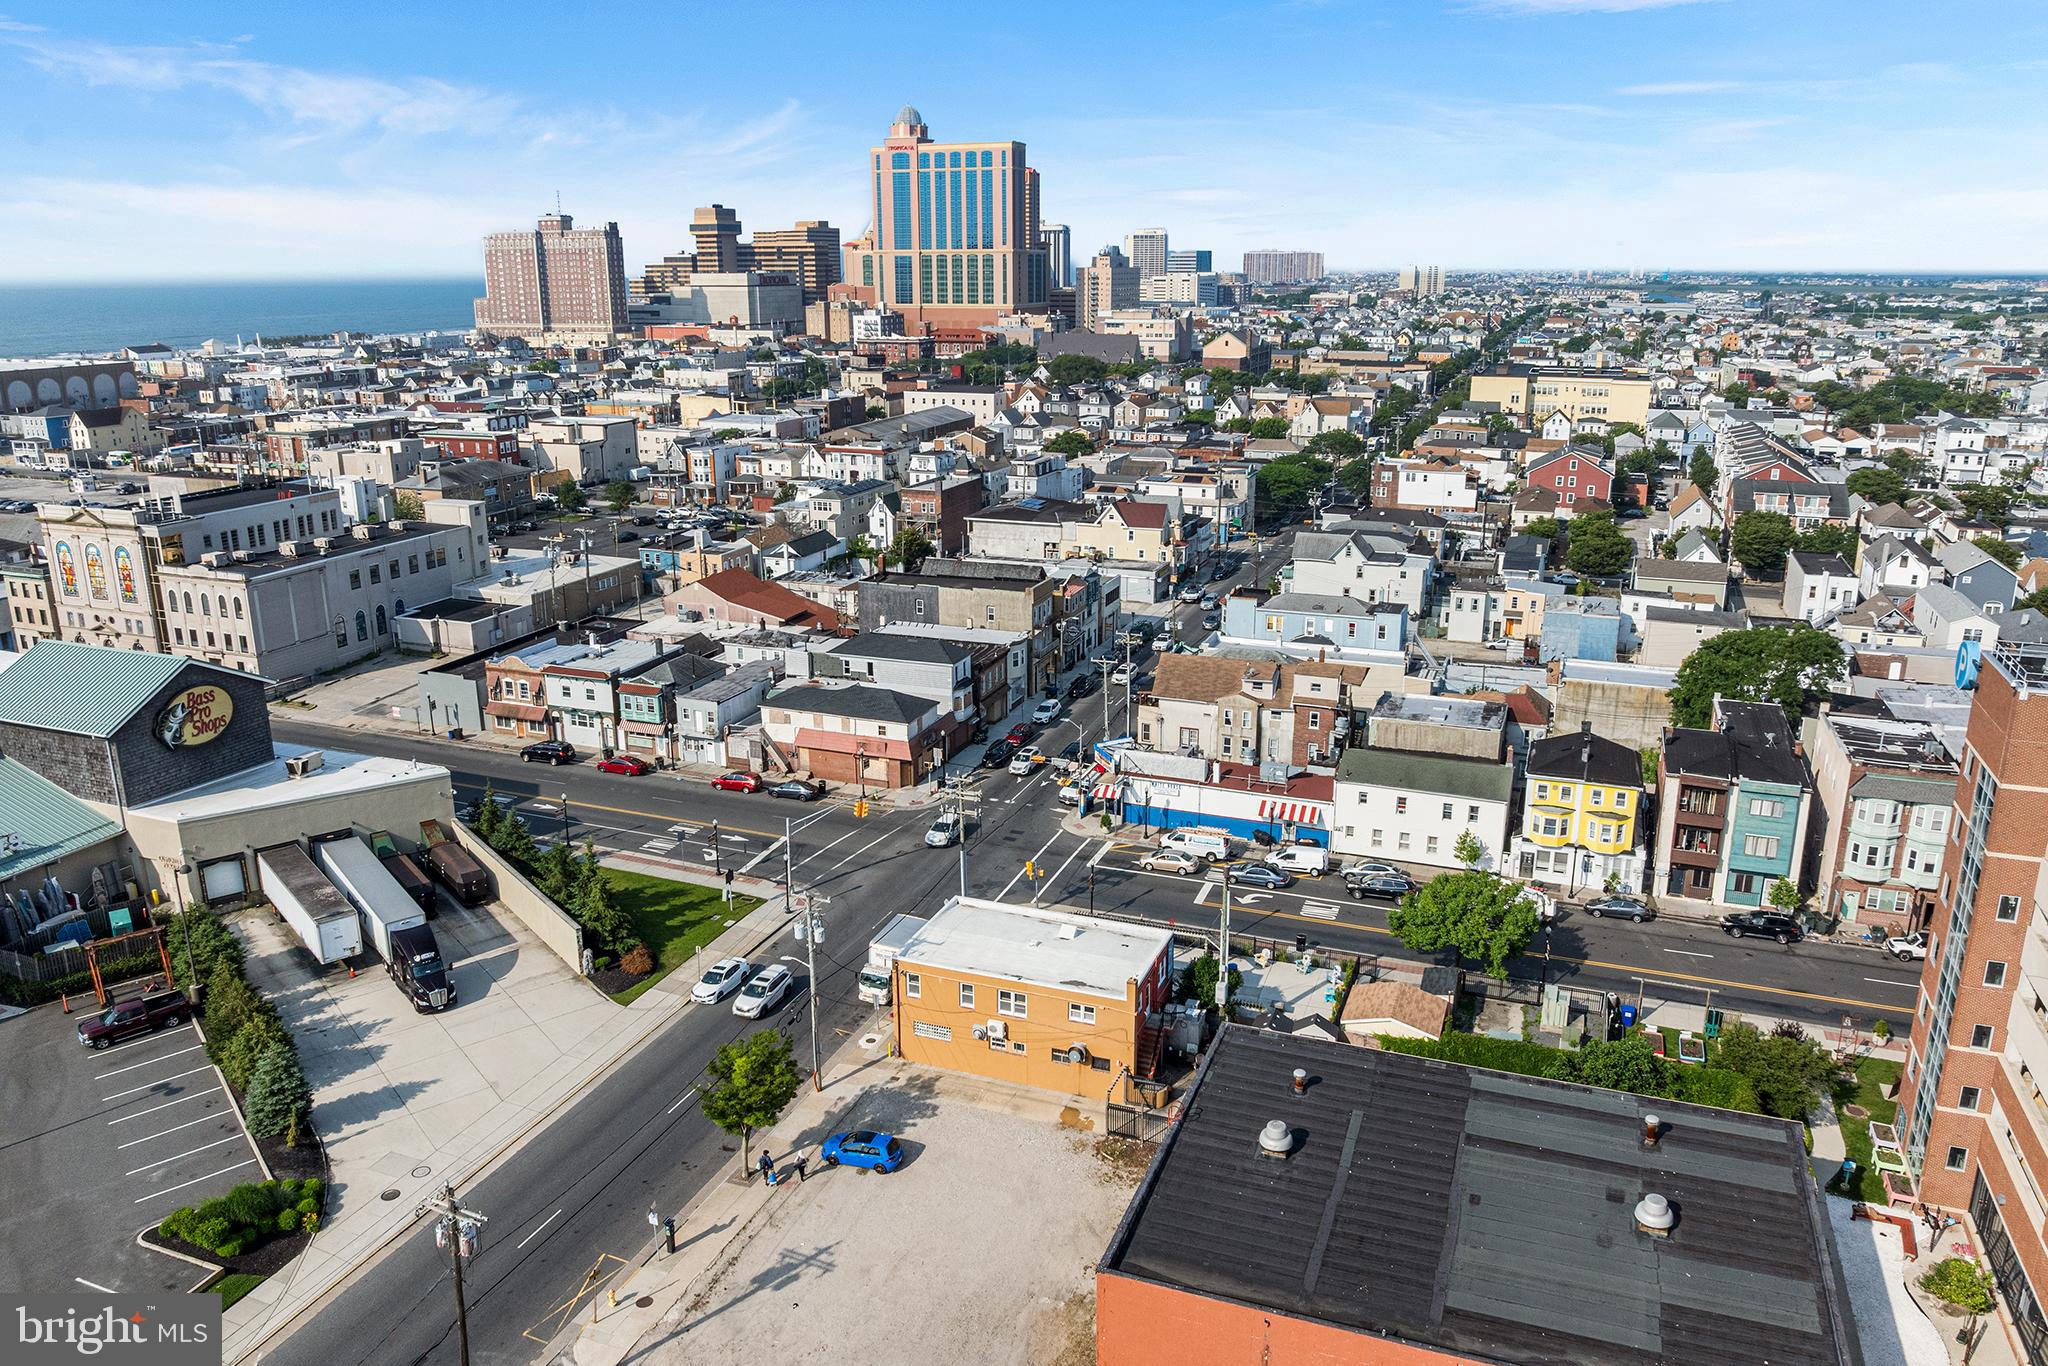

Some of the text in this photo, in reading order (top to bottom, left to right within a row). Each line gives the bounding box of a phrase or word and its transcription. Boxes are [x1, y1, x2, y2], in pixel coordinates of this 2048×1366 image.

[186, 690, 216, 709] Bass
[190, 705, 211, 723] Pro
[191, 714, 227, 737] Shops
